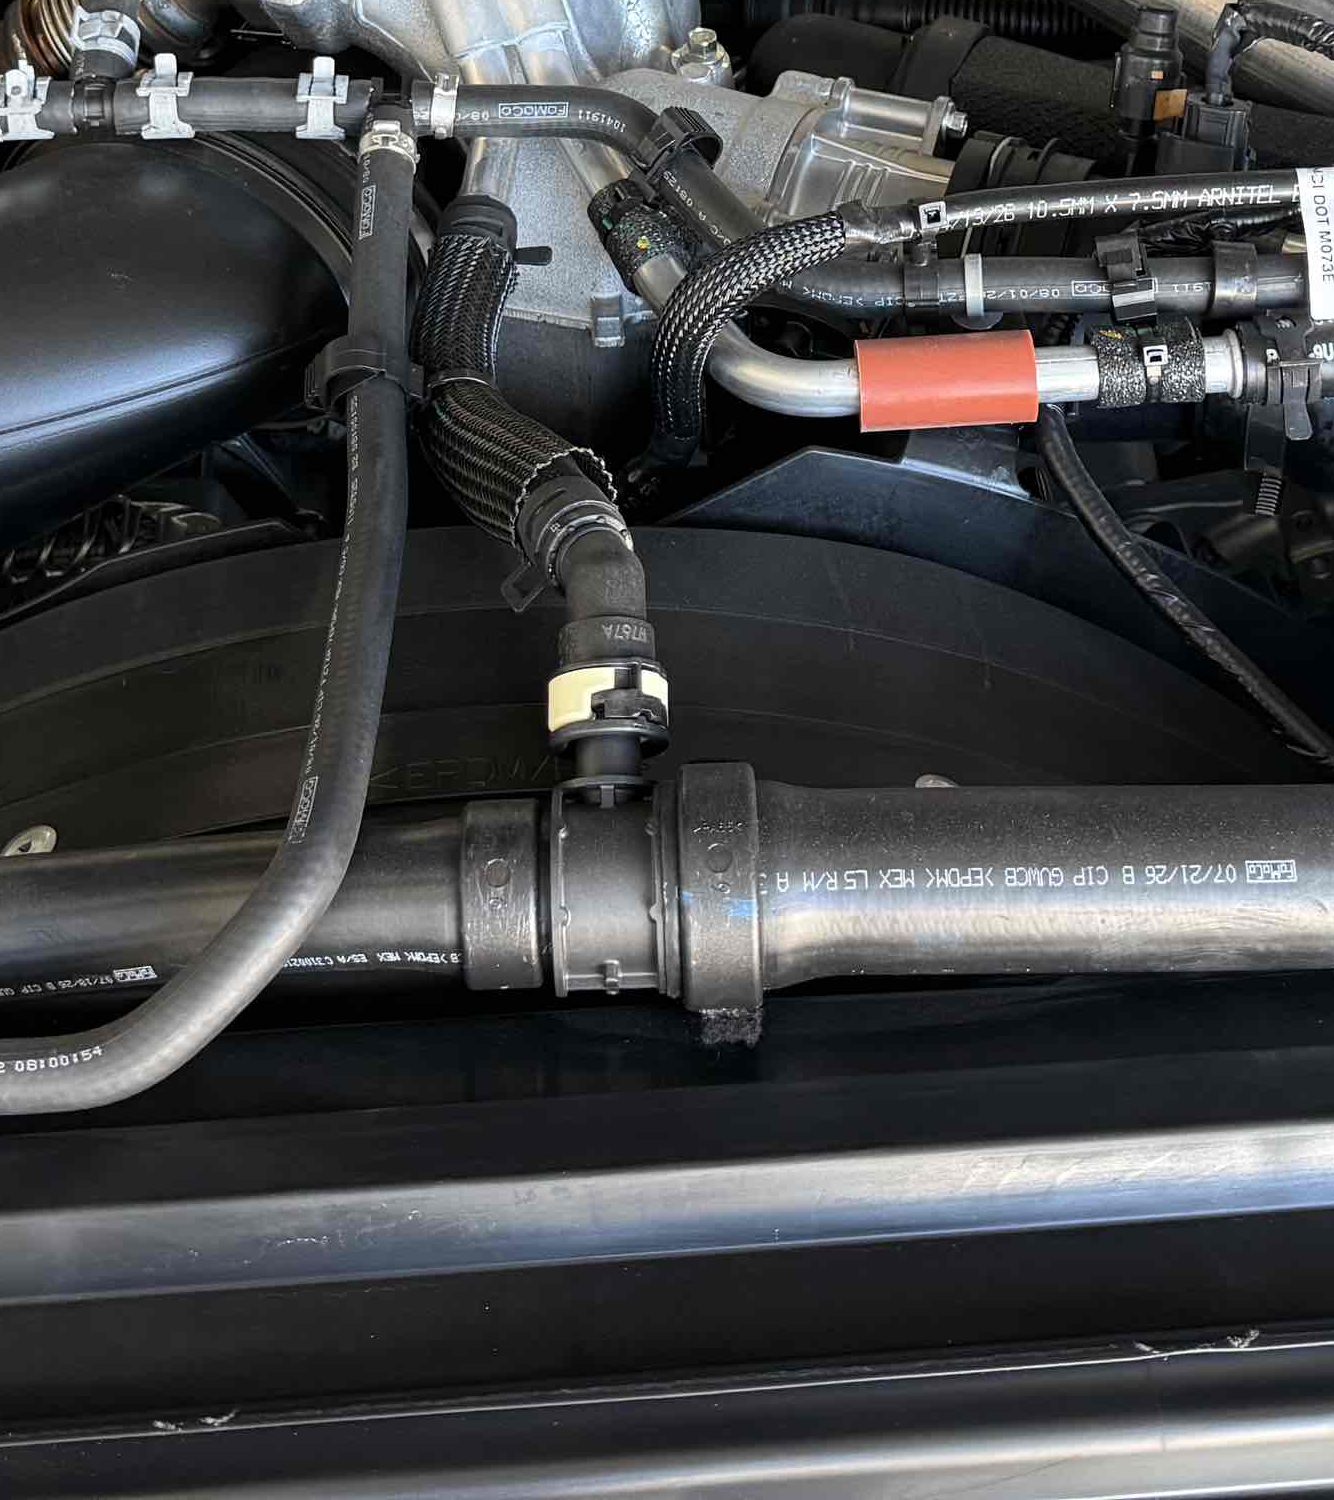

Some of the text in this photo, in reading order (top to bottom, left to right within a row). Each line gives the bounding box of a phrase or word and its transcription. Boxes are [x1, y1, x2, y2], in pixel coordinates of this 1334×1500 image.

[498, 101, 569, 119] FoMoCo
[1027, 198, 1094, 220] 10.5MM
[1104, 195, 1118, 214] X
[1129, 189, 1188, 212] 7.5MM
[1197, 184, 1281, 208] ARNITEL
[1313, 194, 1330, 232] DOT
[1319, 229, 1334, 284] M073E
[776, 871, 789, 893] A
[801, 870, 838, 892] R/M
[878, 868, 915, 890] MEX
[1072, 865, 1109, 887] CIP
[1122, 864, 1136, 886] B
[1144, 863, 1238, 884] 07/21/26
[1245, 859, 1298, 884] FoMoCo
